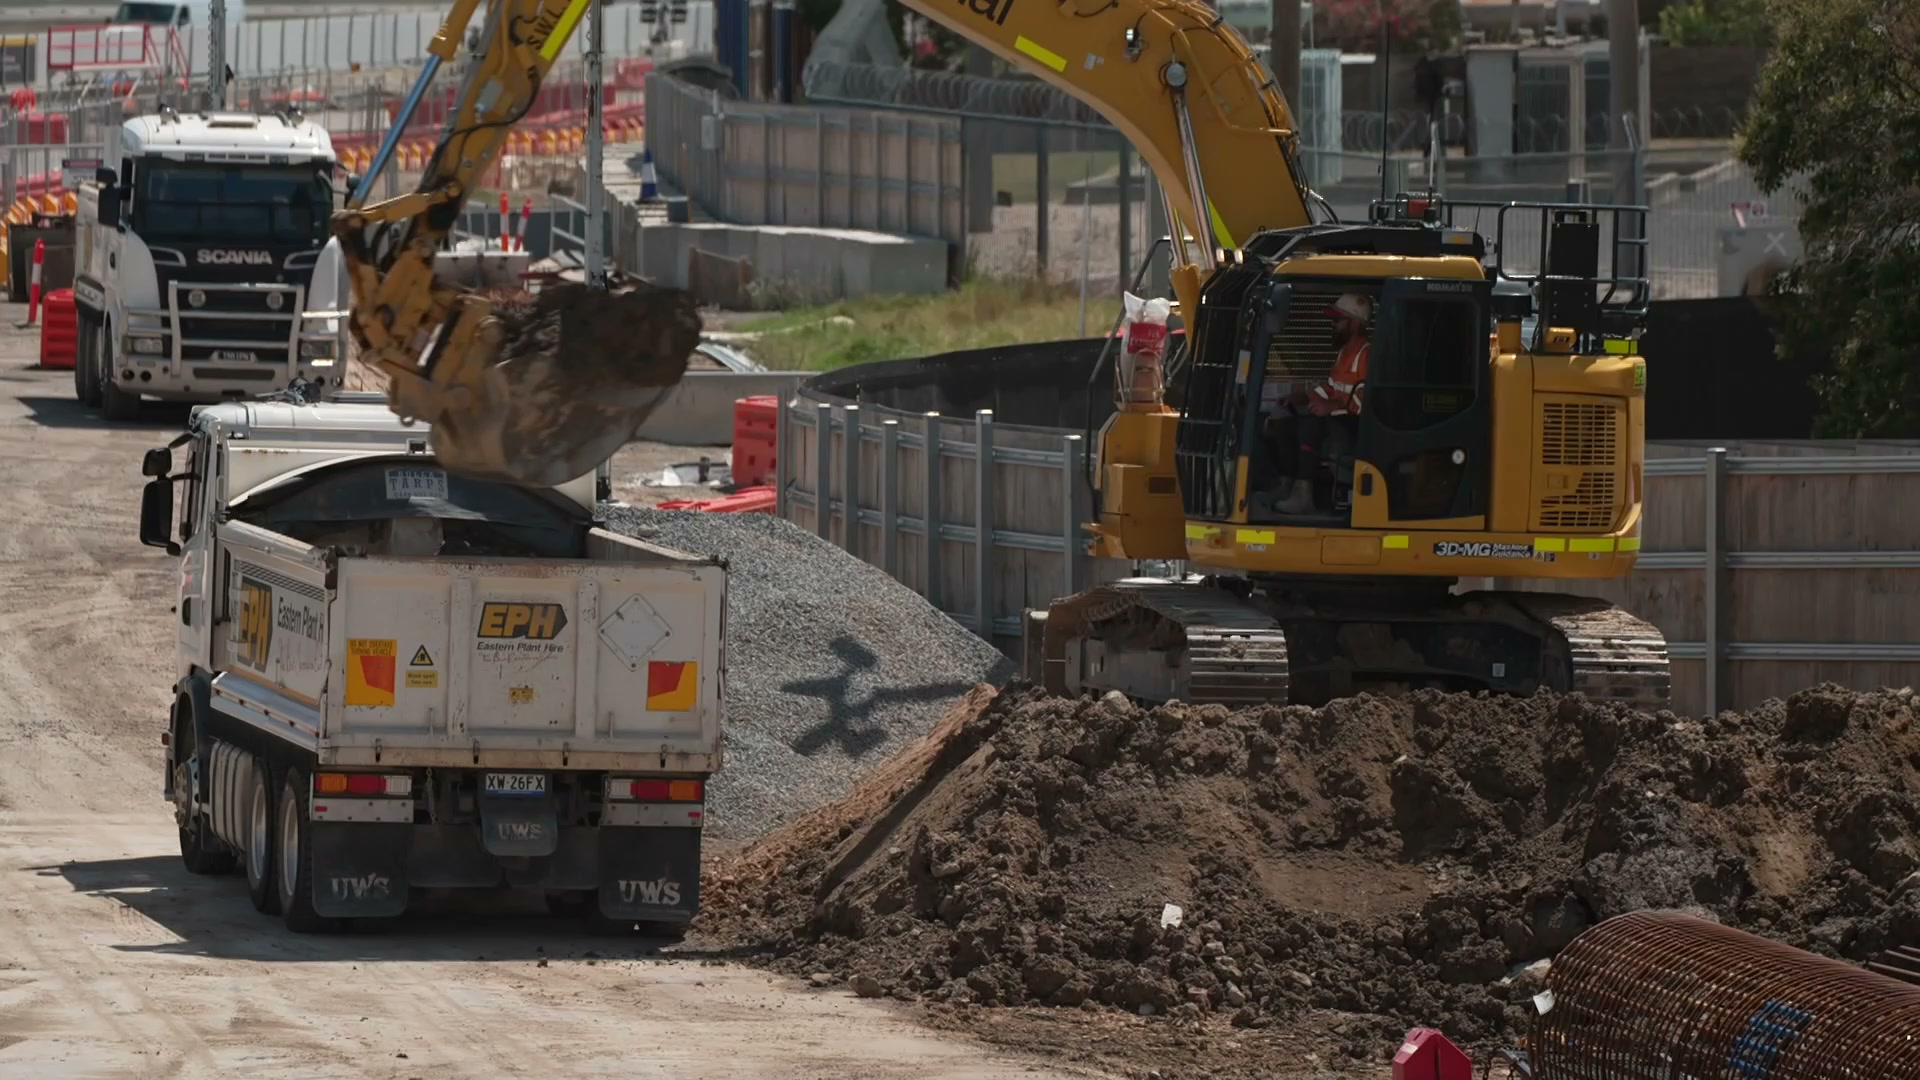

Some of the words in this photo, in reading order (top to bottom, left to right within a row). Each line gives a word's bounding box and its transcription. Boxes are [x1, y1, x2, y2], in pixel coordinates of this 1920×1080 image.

[197, 249, 272, 264] SCANIA
[390, 478, 445, 492] TARPS
[1435, 542, 1491, 557] 3D-MG
[1492, 543, 1529, 551] Machine
[1492, 550, 1531, 559] Guidance
[238, 581, 271, 666] EPH
[278, 596, 302, 635] Eastern
[302, 605, 319, 641] Plant
[480, 604, 558, 638] EPH
[476, 641, 514, 651] Eastern
[517, 643, 541, 652] Plant
[544, 643, 564, 653] Hire
[497, 823, 542, 840] UWS
[330, 872, 391, 899] UWS
[618, 877, 680, 905] UWS
